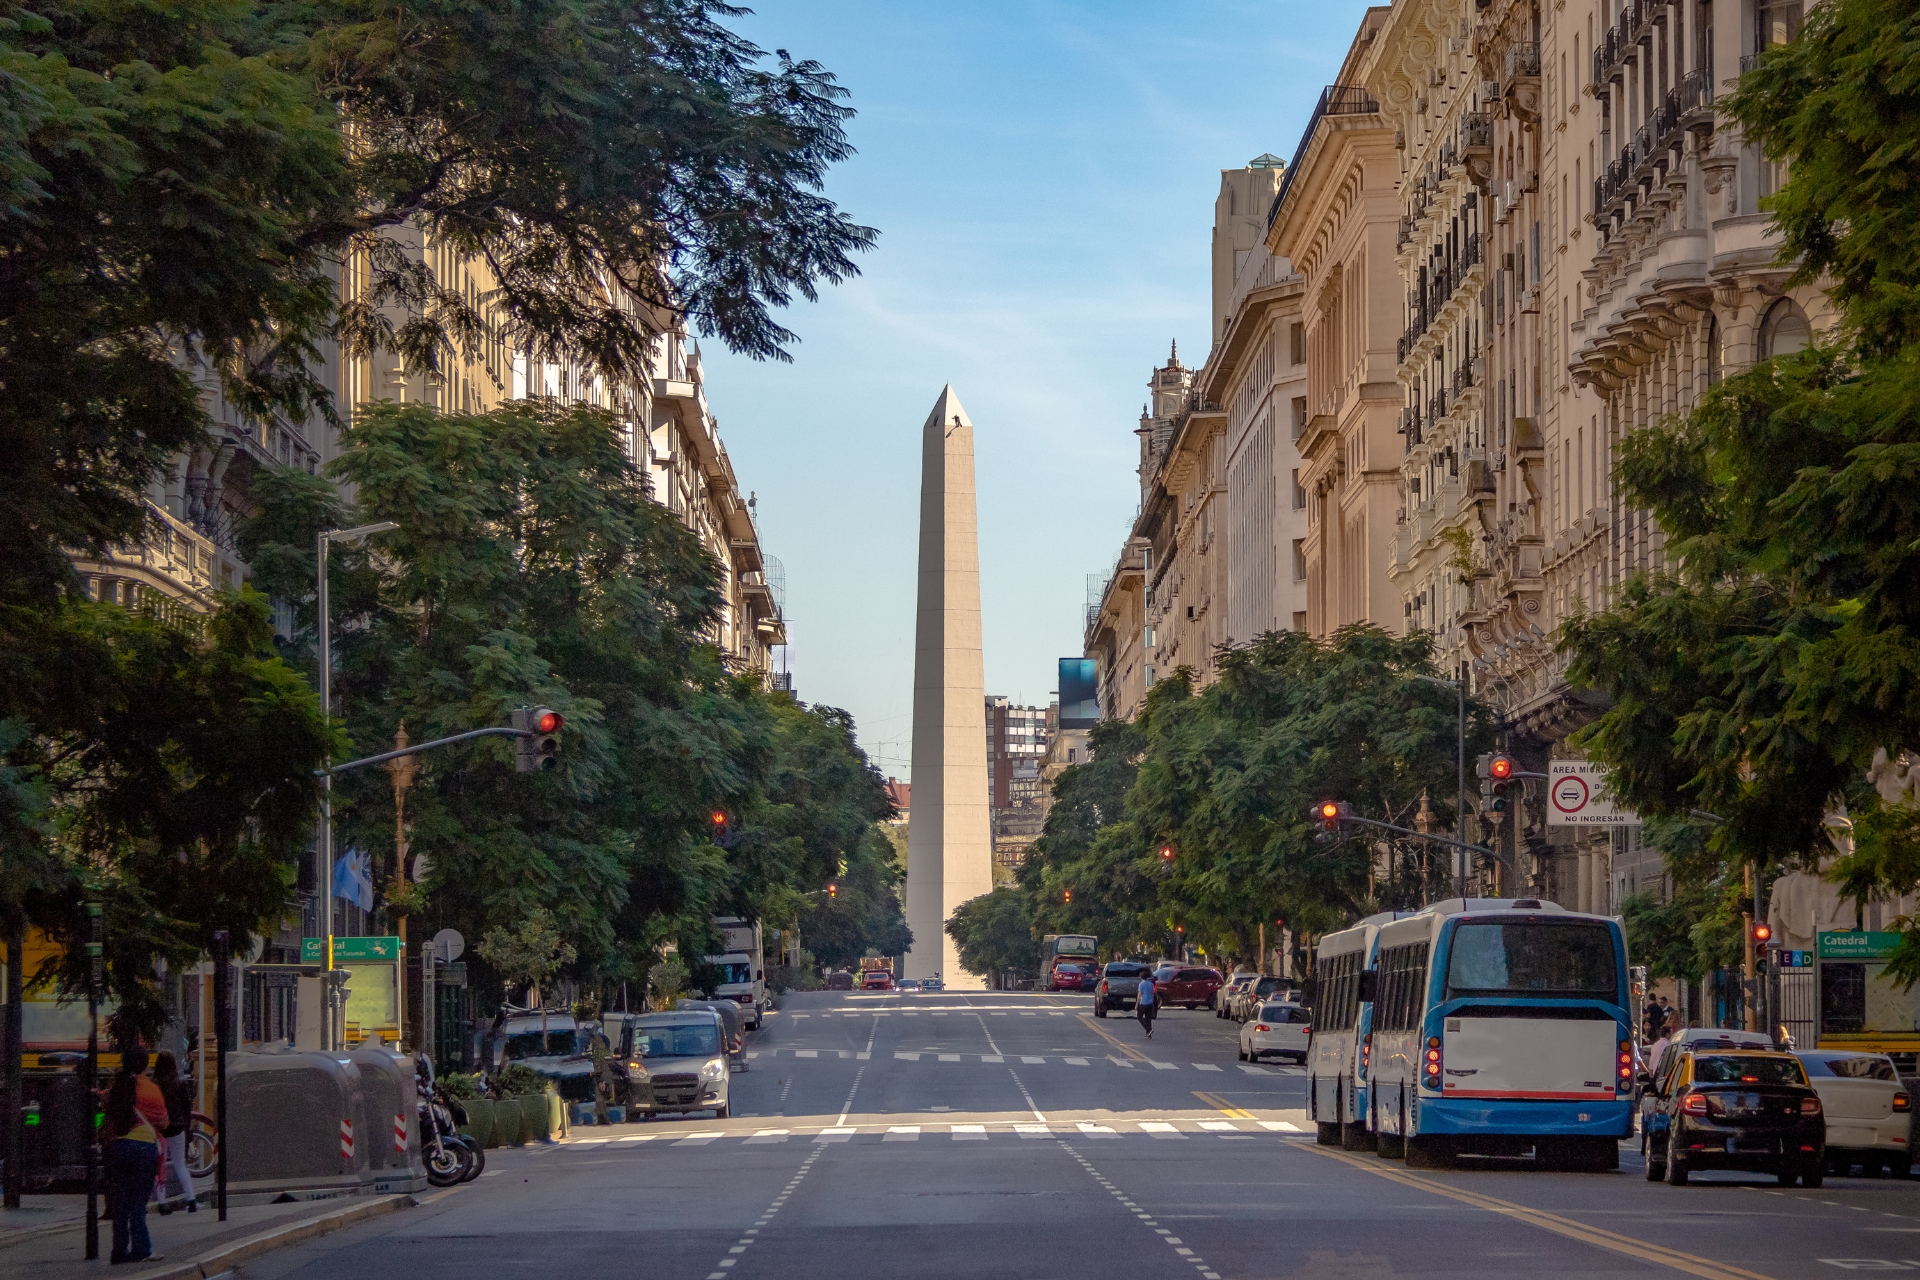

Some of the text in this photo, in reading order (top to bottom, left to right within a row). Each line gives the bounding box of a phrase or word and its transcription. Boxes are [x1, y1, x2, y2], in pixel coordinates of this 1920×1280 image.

[1553, 766, 1576, 774] AREA
[1565, 815, 1625, 823] NO INGRESAR
[1824, 935, 1868, 946] Catedral
[306, 941, 345, 950] Catral
[1784, 953, 1812, 965] E A D
